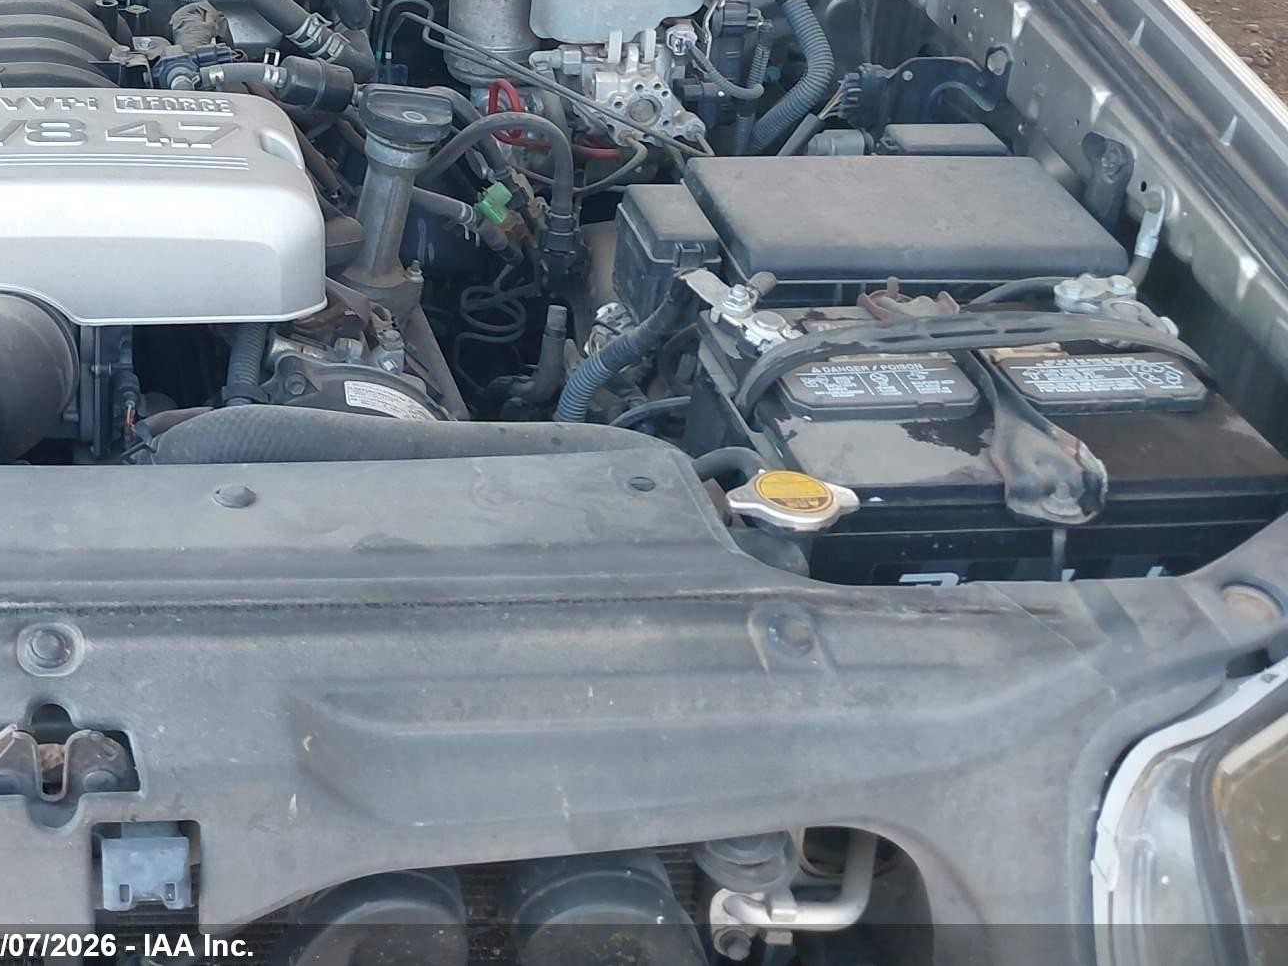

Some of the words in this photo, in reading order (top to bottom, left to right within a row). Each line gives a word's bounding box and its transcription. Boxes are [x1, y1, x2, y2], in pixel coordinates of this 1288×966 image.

[105, 120, 241, 148] 4.7
[822, 365, 870, 373] DANGER
[879, 363, 924, 372] POISON
